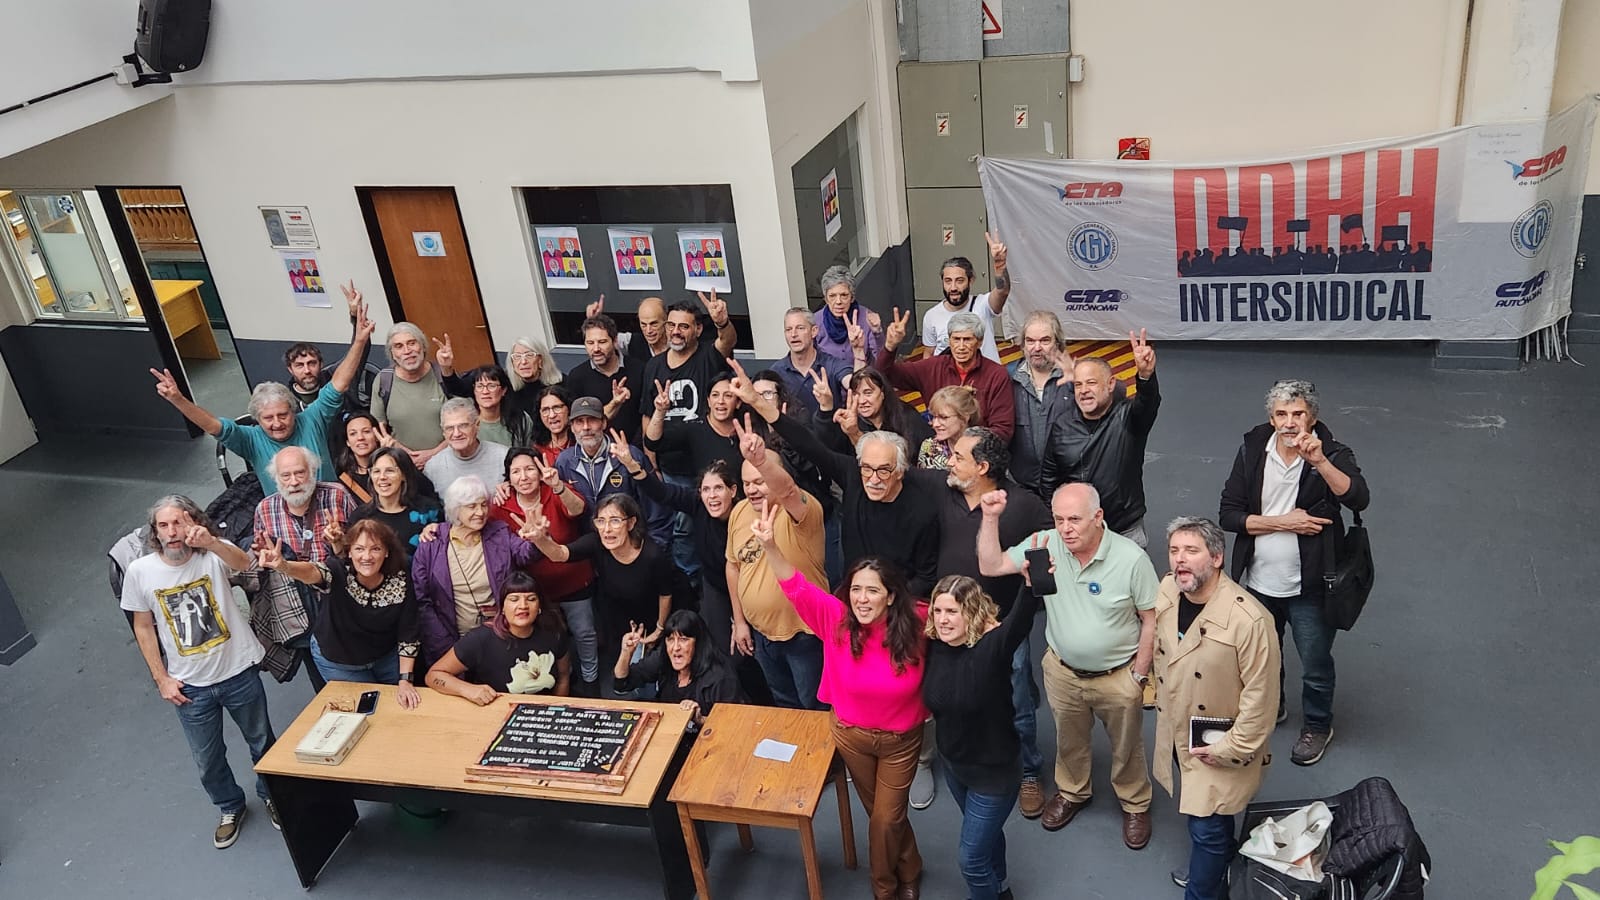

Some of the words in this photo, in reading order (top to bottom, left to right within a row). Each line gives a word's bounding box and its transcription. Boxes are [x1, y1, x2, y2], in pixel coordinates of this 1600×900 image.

[1520, 145, 1567, 177] CTA
[1064, 181, 1123, 199] CTA
[1064, 289, 1121, 303] CTA
[1496, 270, 1545, 298] CTA
[1179, 279, 1432, 322] INTERSINDICAL
